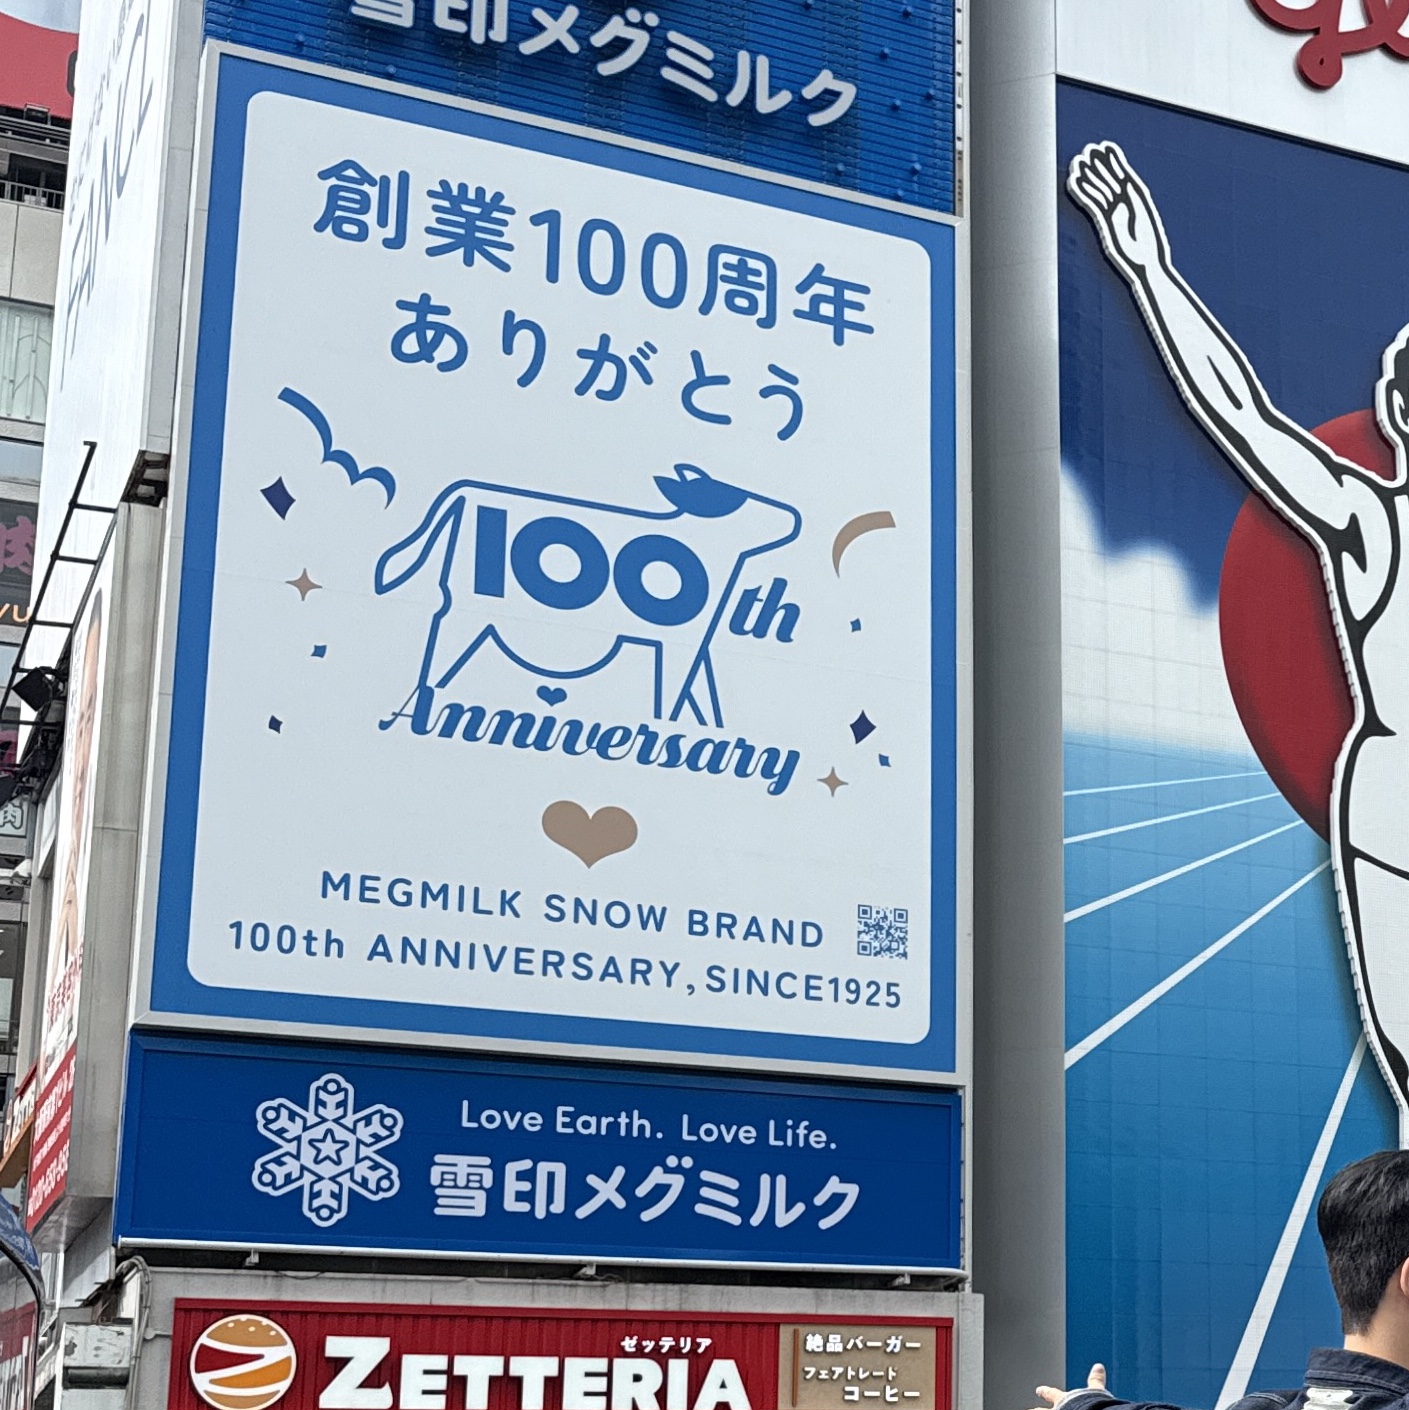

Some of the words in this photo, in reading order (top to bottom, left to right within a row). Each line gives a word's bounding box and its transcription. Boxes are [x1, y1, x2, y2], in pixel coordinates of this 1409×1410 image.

[312, 158, 875, 347] 創業100周年
[389, 292, 804, 441] ありがとう
[378, 686, 802, 796] Anniversary
[320, 870, 522, 919] MEGMILK
[544, 893, 669, 934] SNOW
[687, 908, 824, 949] BRAND
[227, 919, 345, 961] 100th
[461, 1100, 544, 1133] Love
[556, 1105, 664, 1141] Earth.
[682, 1114, 758, 1144] Love
[767, 1118, 838, 1150] Life.
[430, 1153, 862, 1230] 雪印メグミルク
[620, 1334, 714, 1356] ゼッテリア
[805, 1333, 922, 1353] 絶品バーガー
[804, 1366, 898, 1381] フェアトレード
[843, 1385, 921, 1402] コーヒー
